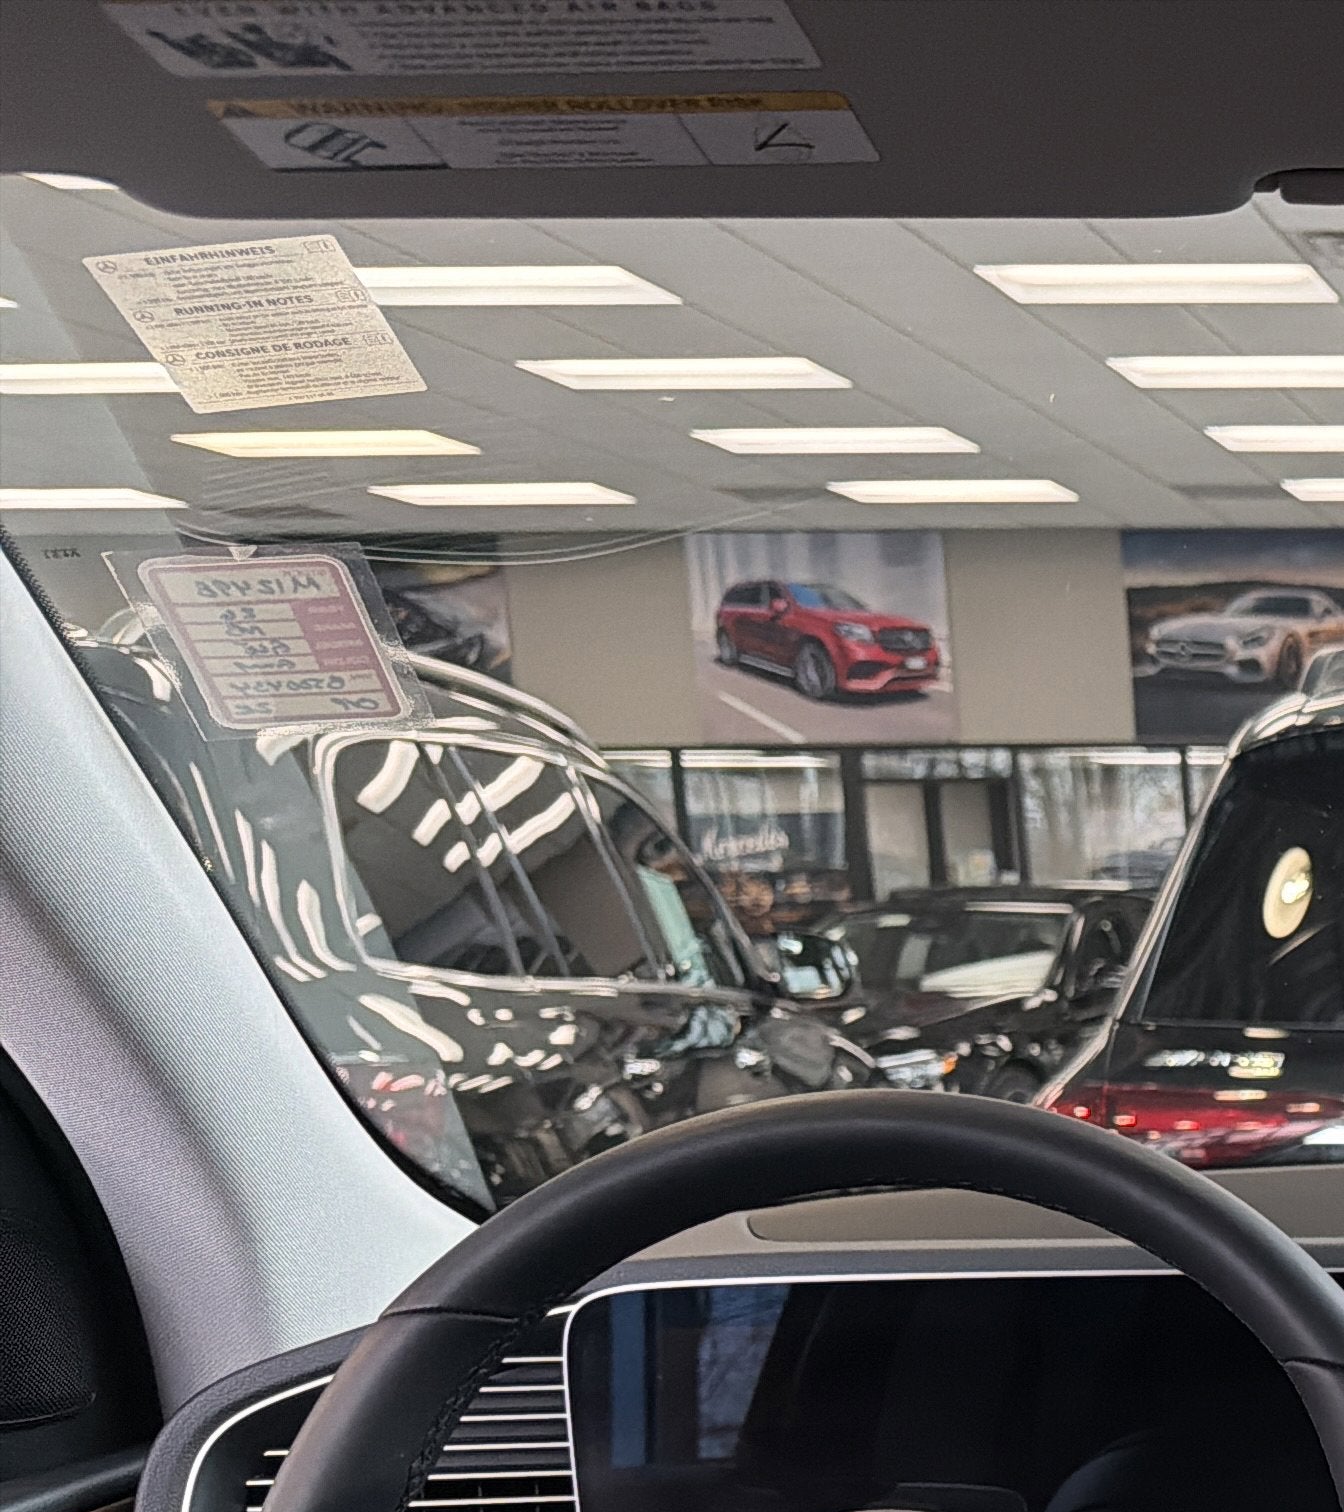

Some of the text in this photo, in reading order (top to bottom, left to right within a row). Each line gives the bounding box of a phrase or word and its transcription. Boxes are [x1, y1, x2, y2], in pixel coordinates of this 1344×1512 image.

[144, 245, 276, 267] EINFAHRHINWEIS
[173, 294, 314, 318] RUNNING-IN NOTES
[194, 336, 351, 361] CONSIGNE DE RODAGE
